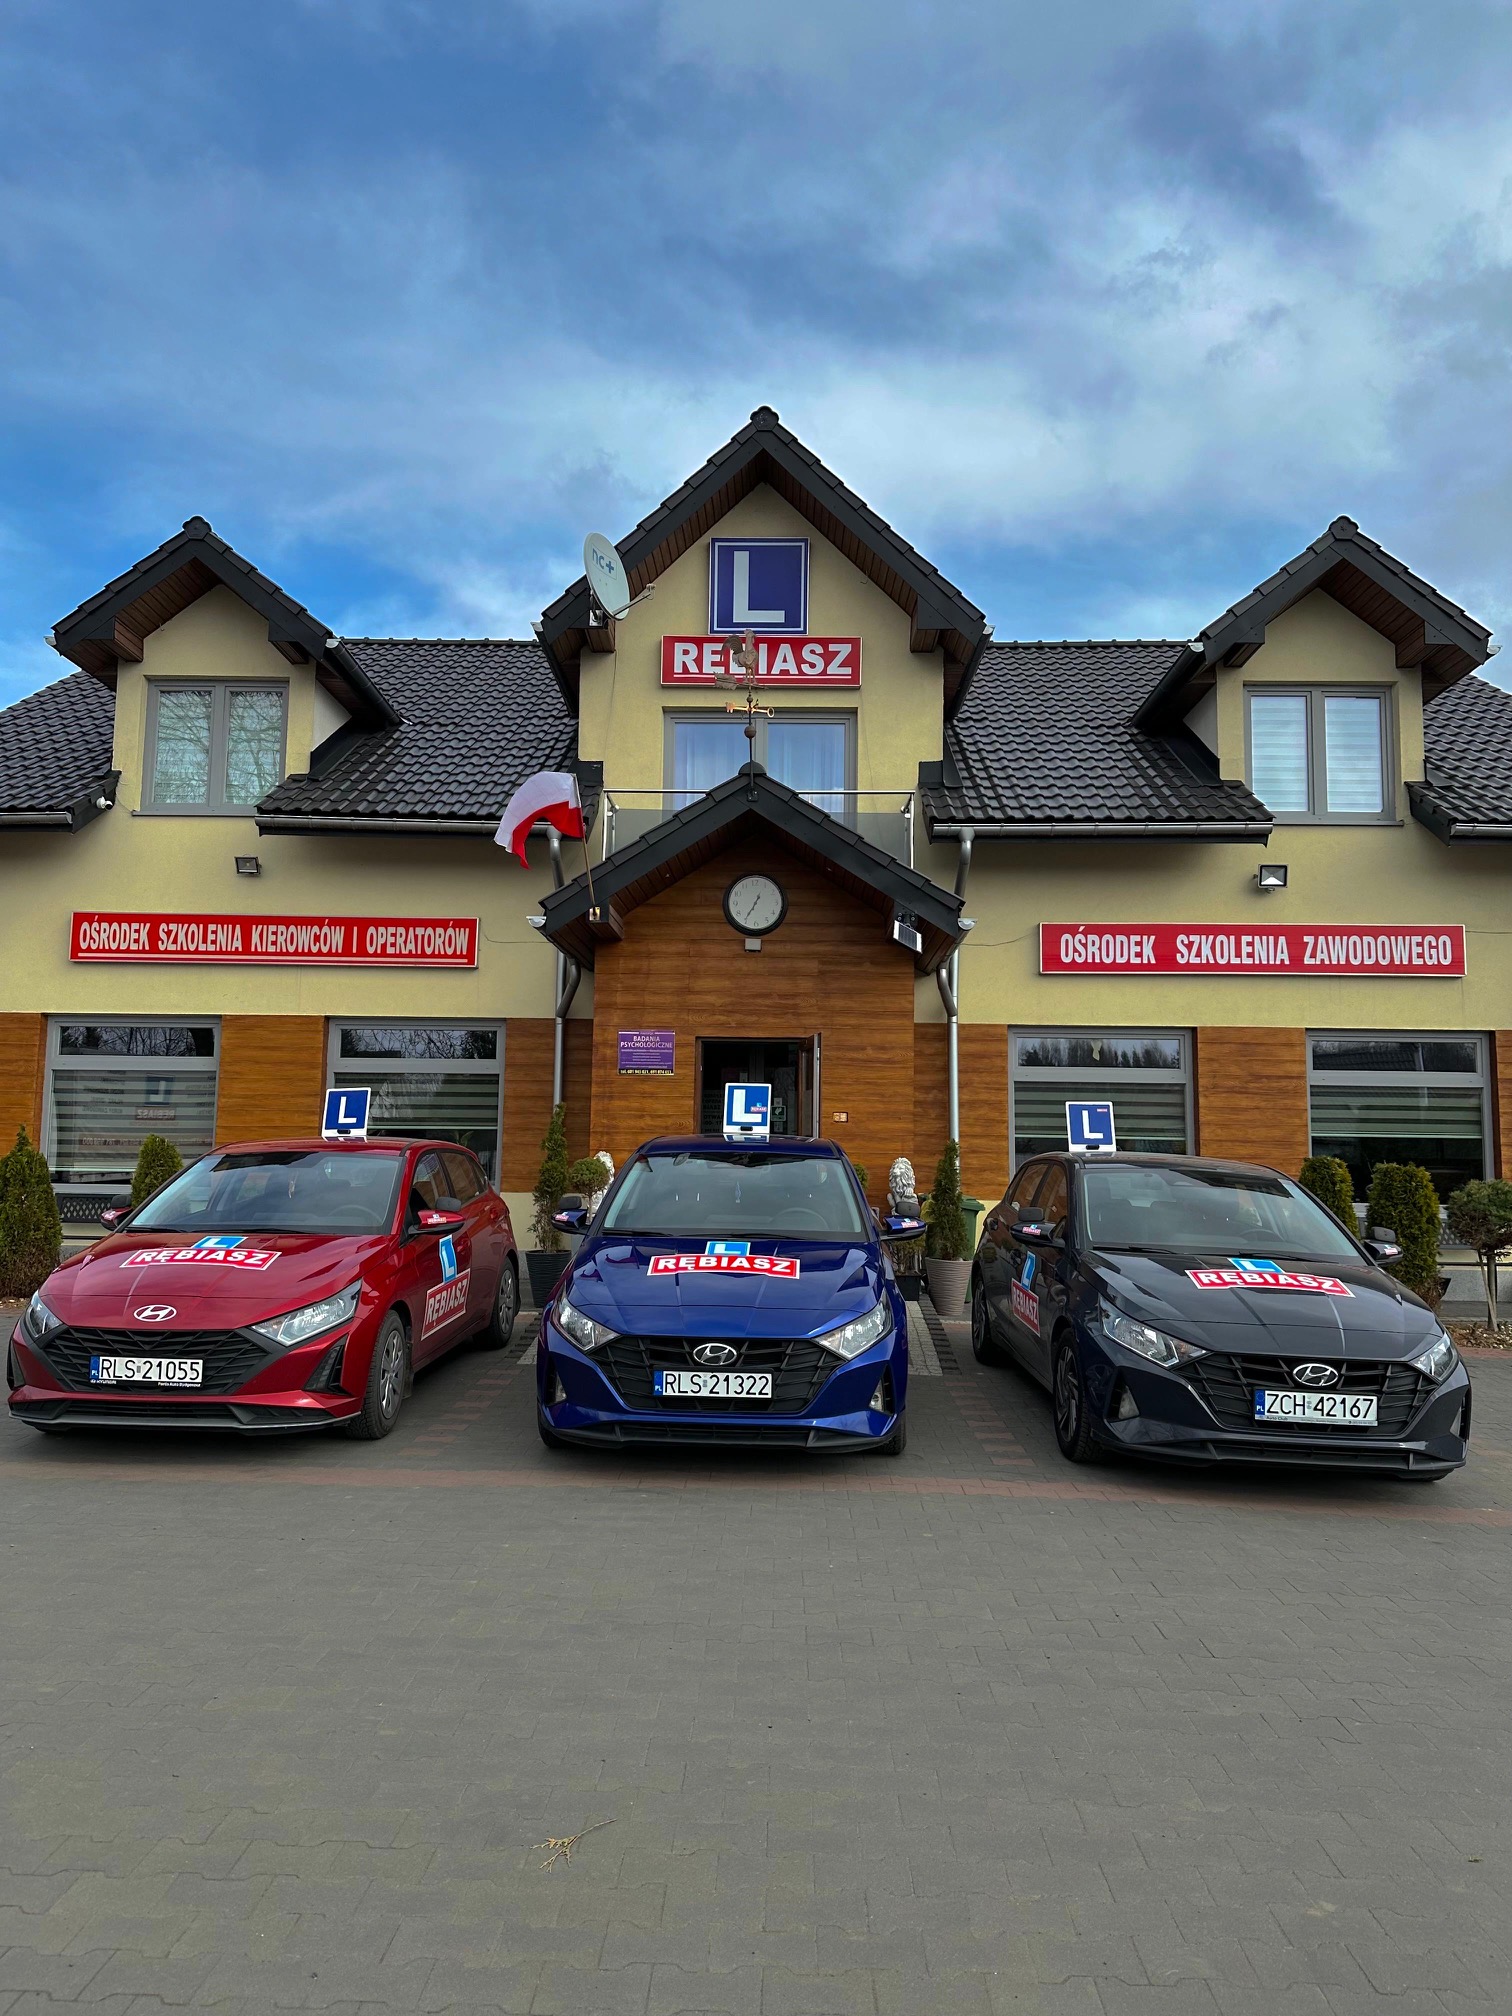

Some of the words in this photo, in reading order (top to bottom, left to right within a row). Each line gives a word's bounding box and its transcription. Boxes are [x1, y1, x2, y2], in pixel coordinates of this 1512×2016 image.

[592, 548, 614, 574] nc+
[732, 550, 785, 623] L
[79, 915, 150, 950] OŚRODEK
[158, 923, 242, 952] SZKOLENIA
[251, 918, 344, 953] KIEROWCÓW
[352, 926, 358, 953] I
[366, 921, 470, 954] OPERATORÓW
[1060, 926, 1156, 964] OŚRODEK
[1176, 934, 1290, 964] SZKOLENIA
[1303, 935, 1452, 966] ZAWODOWEGO
[338, 1096, 357, 1124] L
[732, 1089, 762, 1122] L
[1082, 1110, 1104, 1138] L
[202, 1238, 228, 1248] L
[714, 1244, 742, 1254] L
[132, 1250, 270, 1264] RĘBIASZ
[442, 1246, 454, 1277] L
[657, 1256, 792, 1272] RĘBIASZ
[1239, 1260, 1276, 1272] L
[1022, 1258, 1030, 1286] L
[1197, 1272, 1340, 1290] RĘBIASZ
[425, 1280, 468, 1326] RĘBIASZ
[100, 1358, 136, 1379] RLS
[142, 1360, 200, 1380] 21055
[664, 1373, 702, 1394] RLS
[708, 1374, 769, 1396] 21322
[1266, 1394, 1306, 1416] ZCH
[1312, 1396, 1374, 1418] 42167
